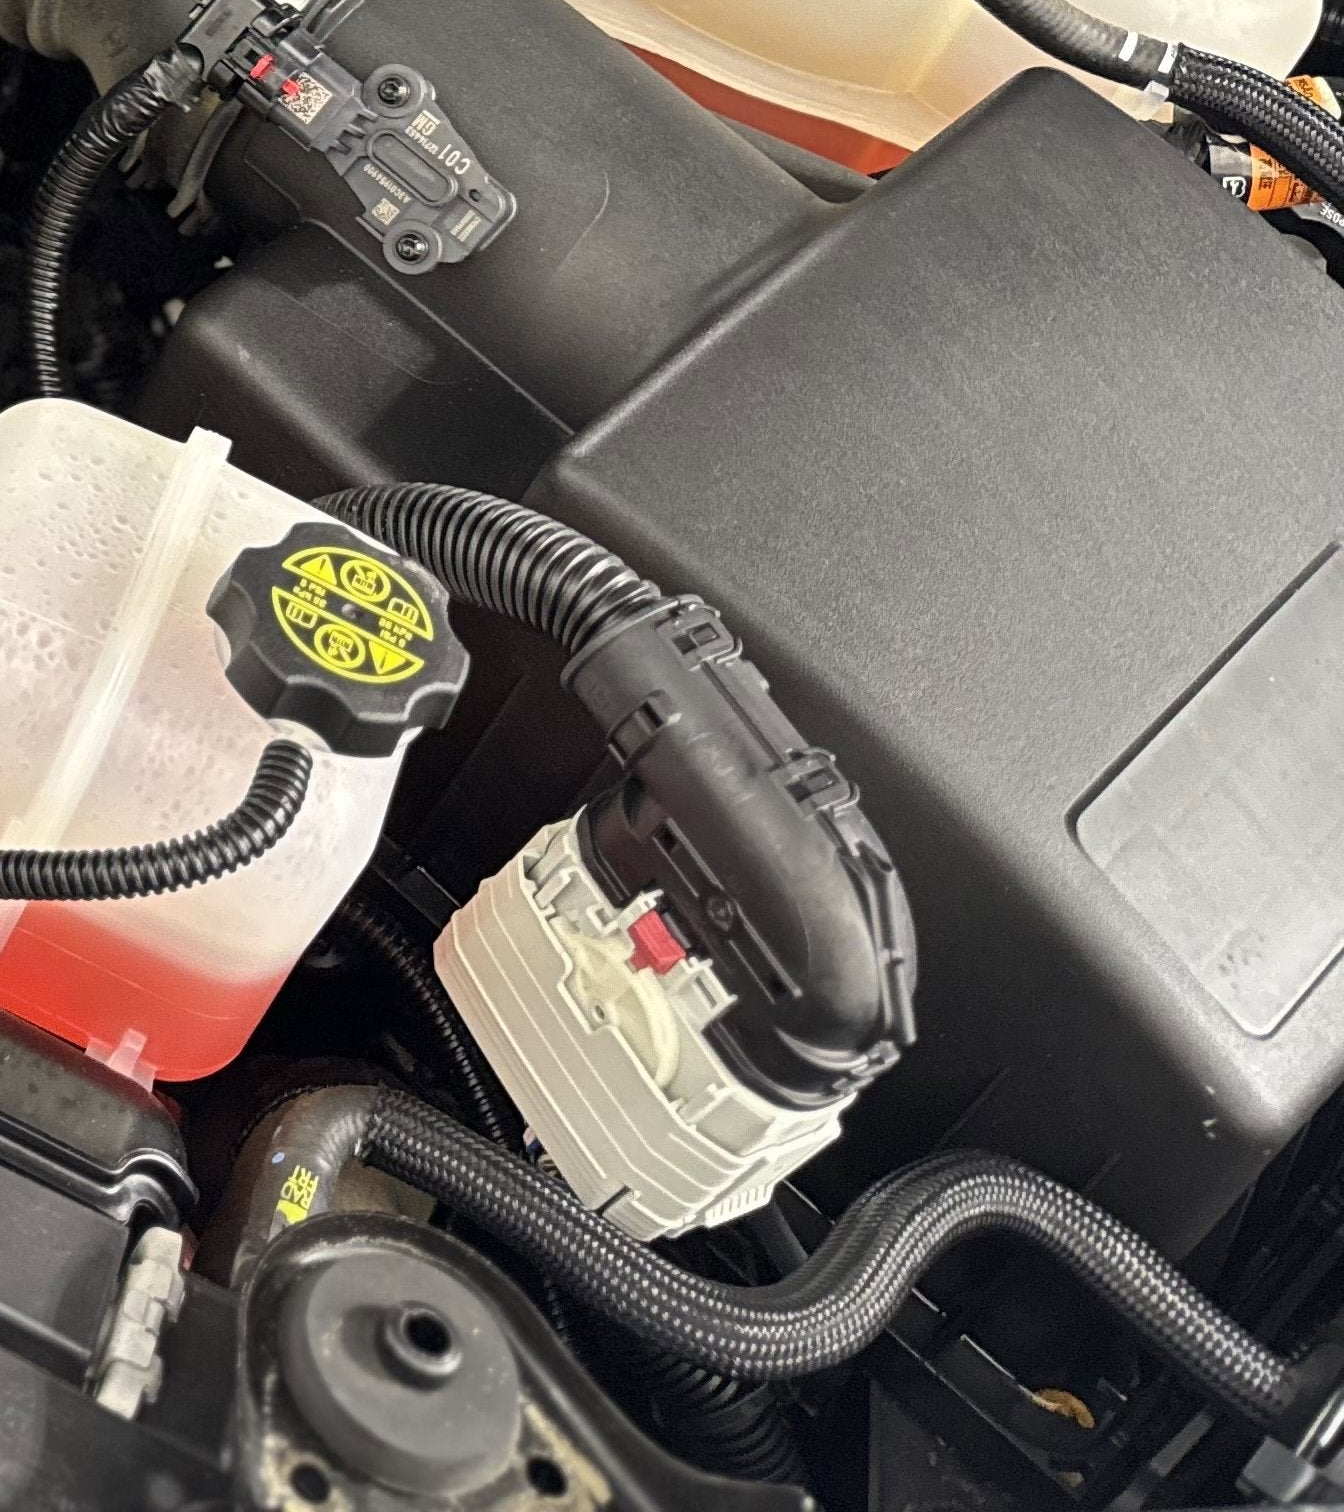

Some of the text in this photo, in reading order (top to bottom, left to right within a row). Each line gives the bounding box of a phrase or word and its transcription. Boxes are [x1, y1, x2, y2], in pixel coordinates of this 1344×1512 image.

[412, 110, 440, 136] GM
[437, 143, 471, 175] C01
[280, 1180, 313, 1209] RAD
